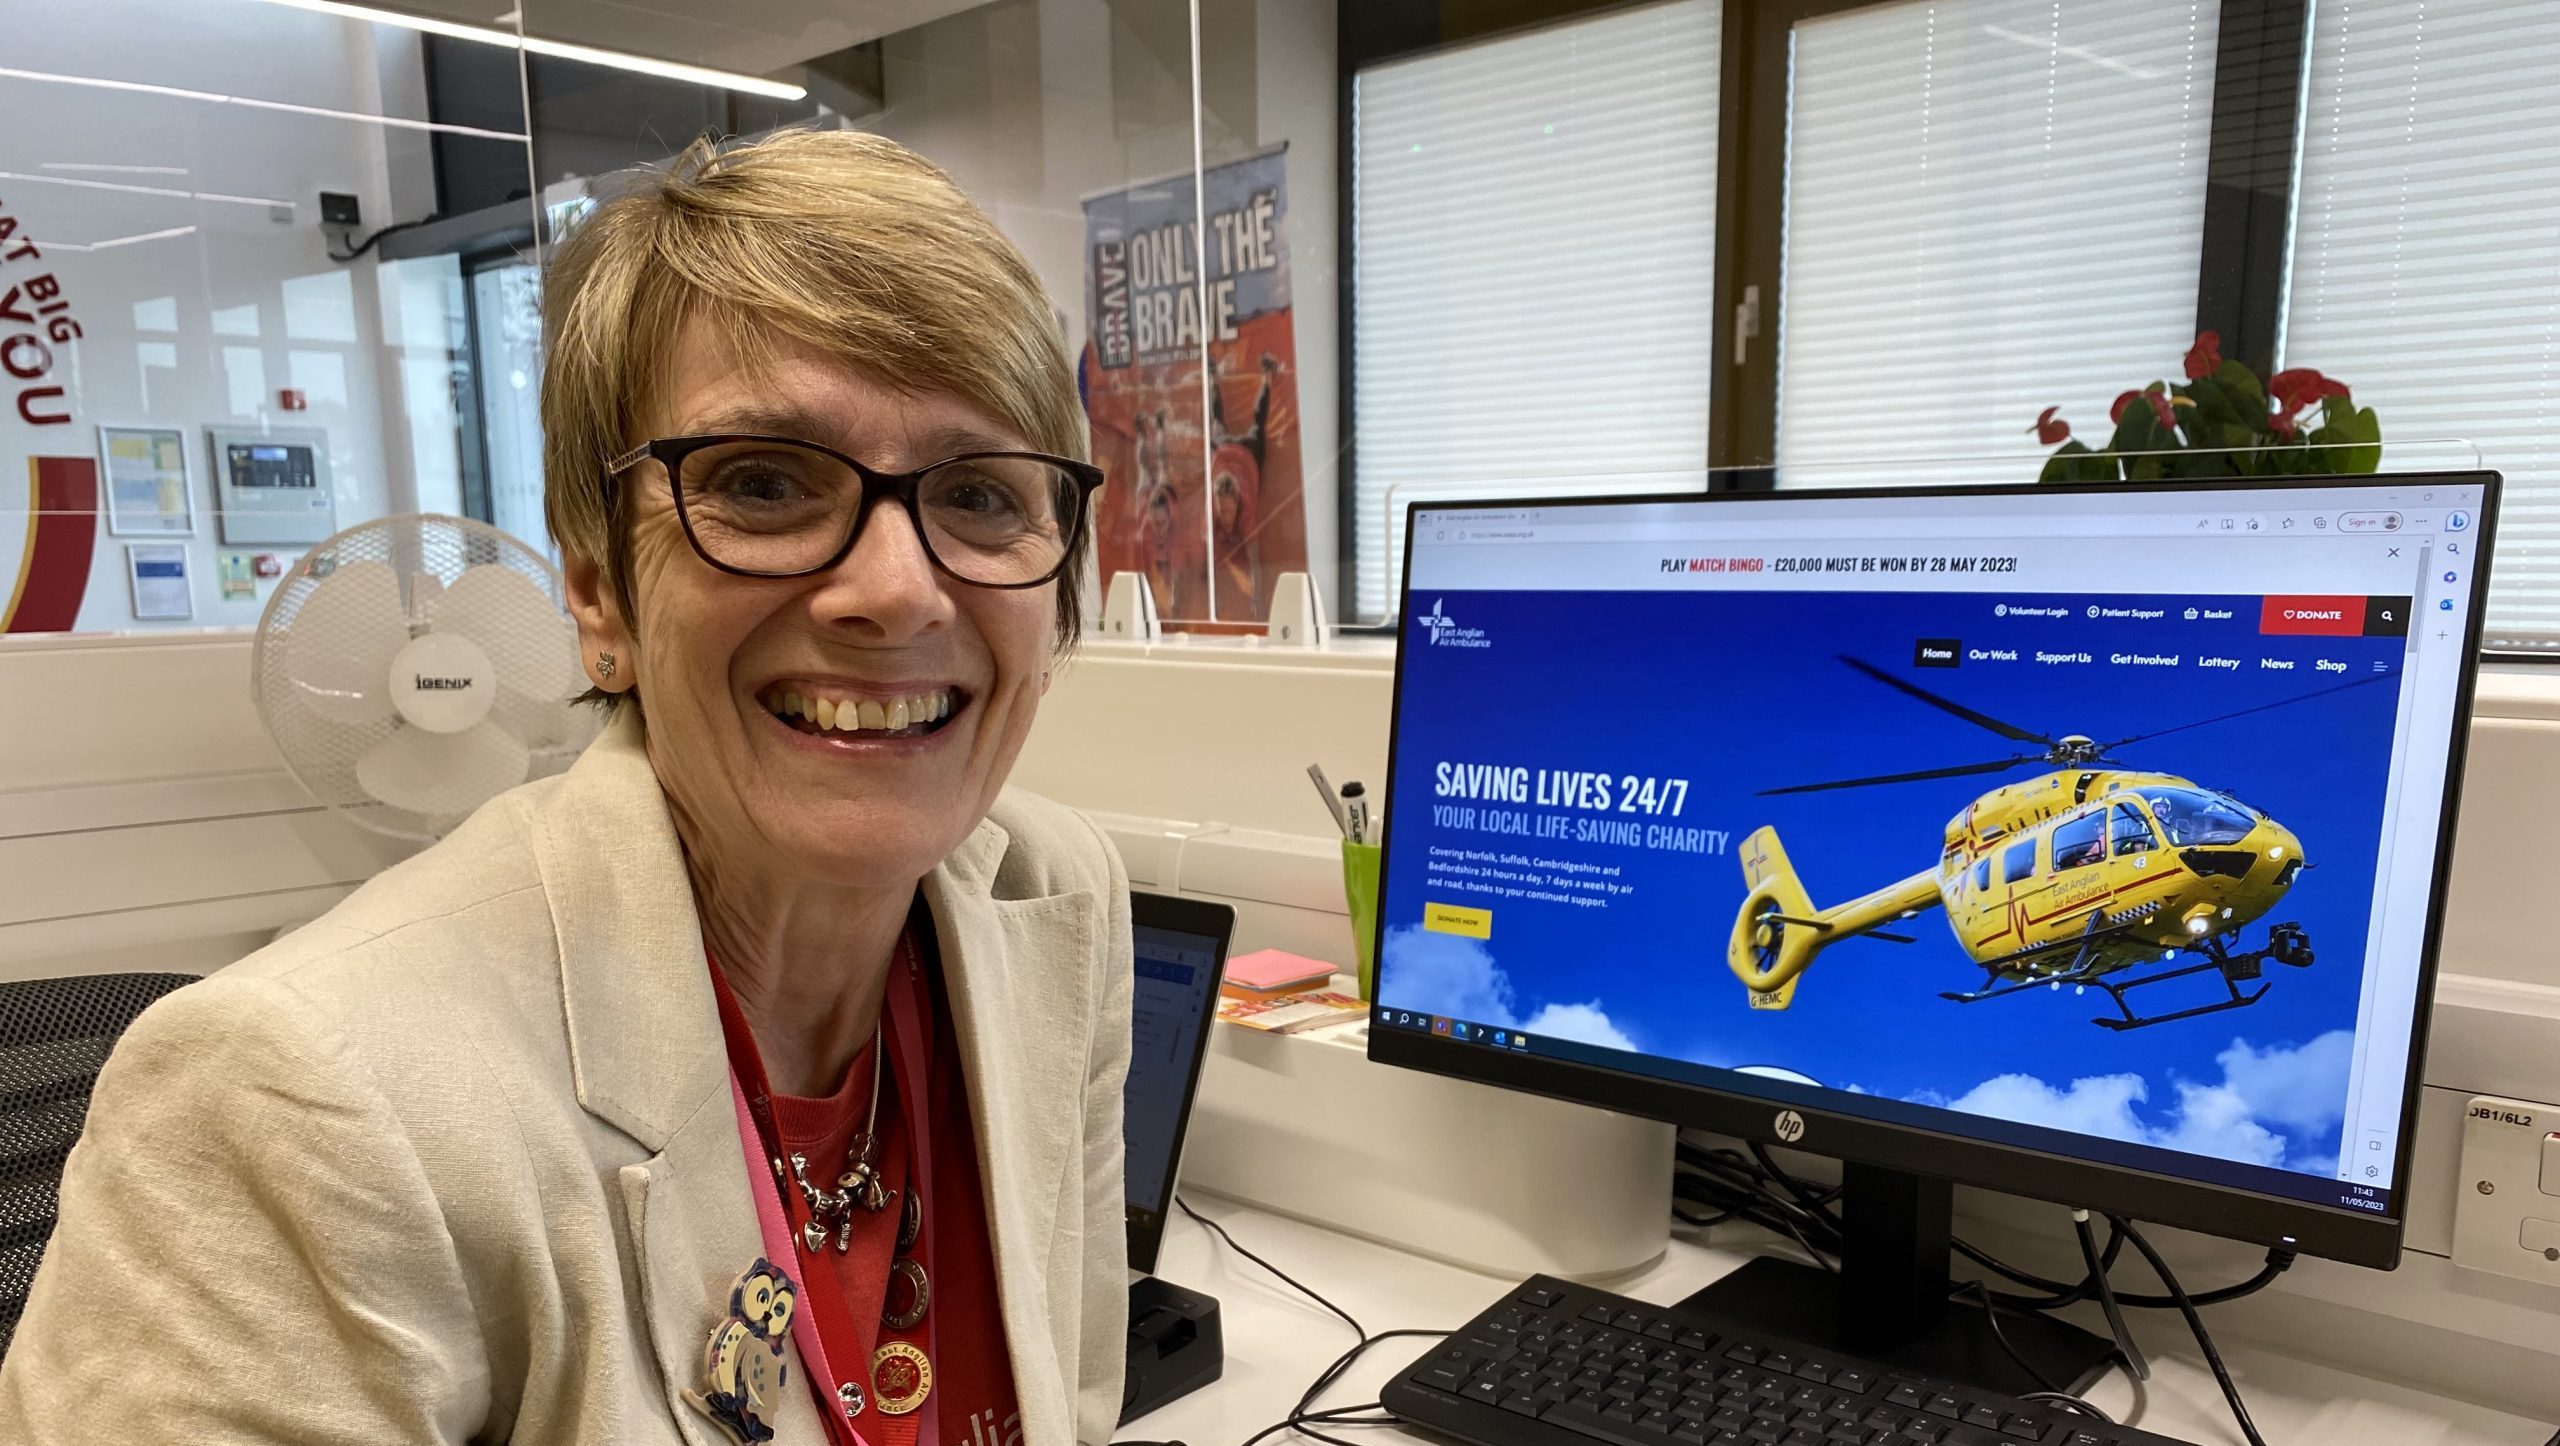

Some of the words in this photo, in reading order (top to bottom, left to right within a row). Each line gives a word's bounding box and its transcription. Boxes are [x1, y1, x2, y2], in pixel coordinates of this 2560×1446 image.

[1215, 203, 1277, 276] THE
[1100, 241, 1131, 356] BRAVE
[24, 272, 84, 344] BIG
[1135, 280, 1239, 352] BRAVE
[0, 285, 72, 426] YOU
[2348, 517, 2366, 527] Sign
[2368, 518, 2376, 526] in
[1661, 559, 1687, 572] PLAY
[1689, 558, 1726, 572] MATCH
[1729, 558, 1764, 572] BINGO
[1774, 558, 1822, 573] £20,000
[1826, 558, 1858, 572] MUST
[1861, 558, 1877, 572] BE
[1880, 558, 1907, 572] WON
[1911, 558, 1927, 572] BY
[1930, 558, 1946, 572] 28
[1950, 558, 1977, 572] MAY
[1980, 558, 2017, 572] 2023!
[2009, 607, 2046, 616] Volunteer
[2047, 608, 2069, 618] Login
[2102, 608, 2130, 617] Patient
[2131, 608, 2164, 619] Support
[2204, 610, 2232, 619] Basket
[2296, 610, 2342, 620] DONATE
[1440, 628, 1456, 637] East
[1456, 628, 1484, 639] Anglian
[1439, 638, 1450, 646] Air
[1450, 638, 1491, 648] Ambulance
[1922, 648, 1952, 659] Home
[1969, 649, 1989, 660] Our
[1990, 650, 2018, 661] Work
[2035, 651, 2076, 665] Support
[2078, 652, 2092, 663] Us
[2111, 653, 2131, 665] Get
[2133, 654, 2178, 666] Involved
[2199, 656, 2240, 671] Lottery
[2261, 658, 2294, 669] News
[2315, 659, 2347, 673] Shop
[1435, 761, 1529, 803] SAVING
[1536, 769, 1612, 811] LIVES
[1619, 775, 1689, 817] 24/7
[1433, 804, 1476, 830] YOUR
[1480, 809, 1531, 836] LOCAL
[1535, 814, 1641, 847] LIFE-SAVING
[1646, 824, 1730, 855] CHARITY
[1429, 846, 1464, 861] Covering
[1465, 850, 1498, 863] Norfolk,
[1500, 854, 1531, 867] Suffolk,
[1533, 857, 1601, 874] Cambridgeshire
[1602, 866, 1620, 876] and
[1428, 861, 1480, 876] Bedfordshire
[1481, 867, 1491, 877] 24
[1493, 869, 1517, 880] hours
[1526, 873, 1543, 885] day,
[1546, 875, 1551, 884] 7
[1553, 876, 1573, 889] days
[1583, 881, 1605, 891] week
[1607, 882, 1619, 895] by
[1620, 884, 1634, 894] air
[2052, 878, 2070, 897] East
[2070, 871, 2100, 890] Anglian
[1427, 878, 1442, 886] and
[1444, 880, 1464, 890] road,
[1466, 882, 1493, 893] thanks
[1495, 886, 1504, 894] to
[1505, 888, 1525, 898] your
[1526, 890, 1569, 903] continued
[1571, 896, 1608, 908] support.
[2054, 896, 2065, 910] Air
[2066, 882, 2109, 905] Ambulance
[2469, 1108, 2532, 1127] DB1/6L2
[2353, 1186, 2374, 1198] 11:43
[2340, 1196, 2384, 1211] 11/05/2023
[902, 1346, 929, 1378] Anglian
